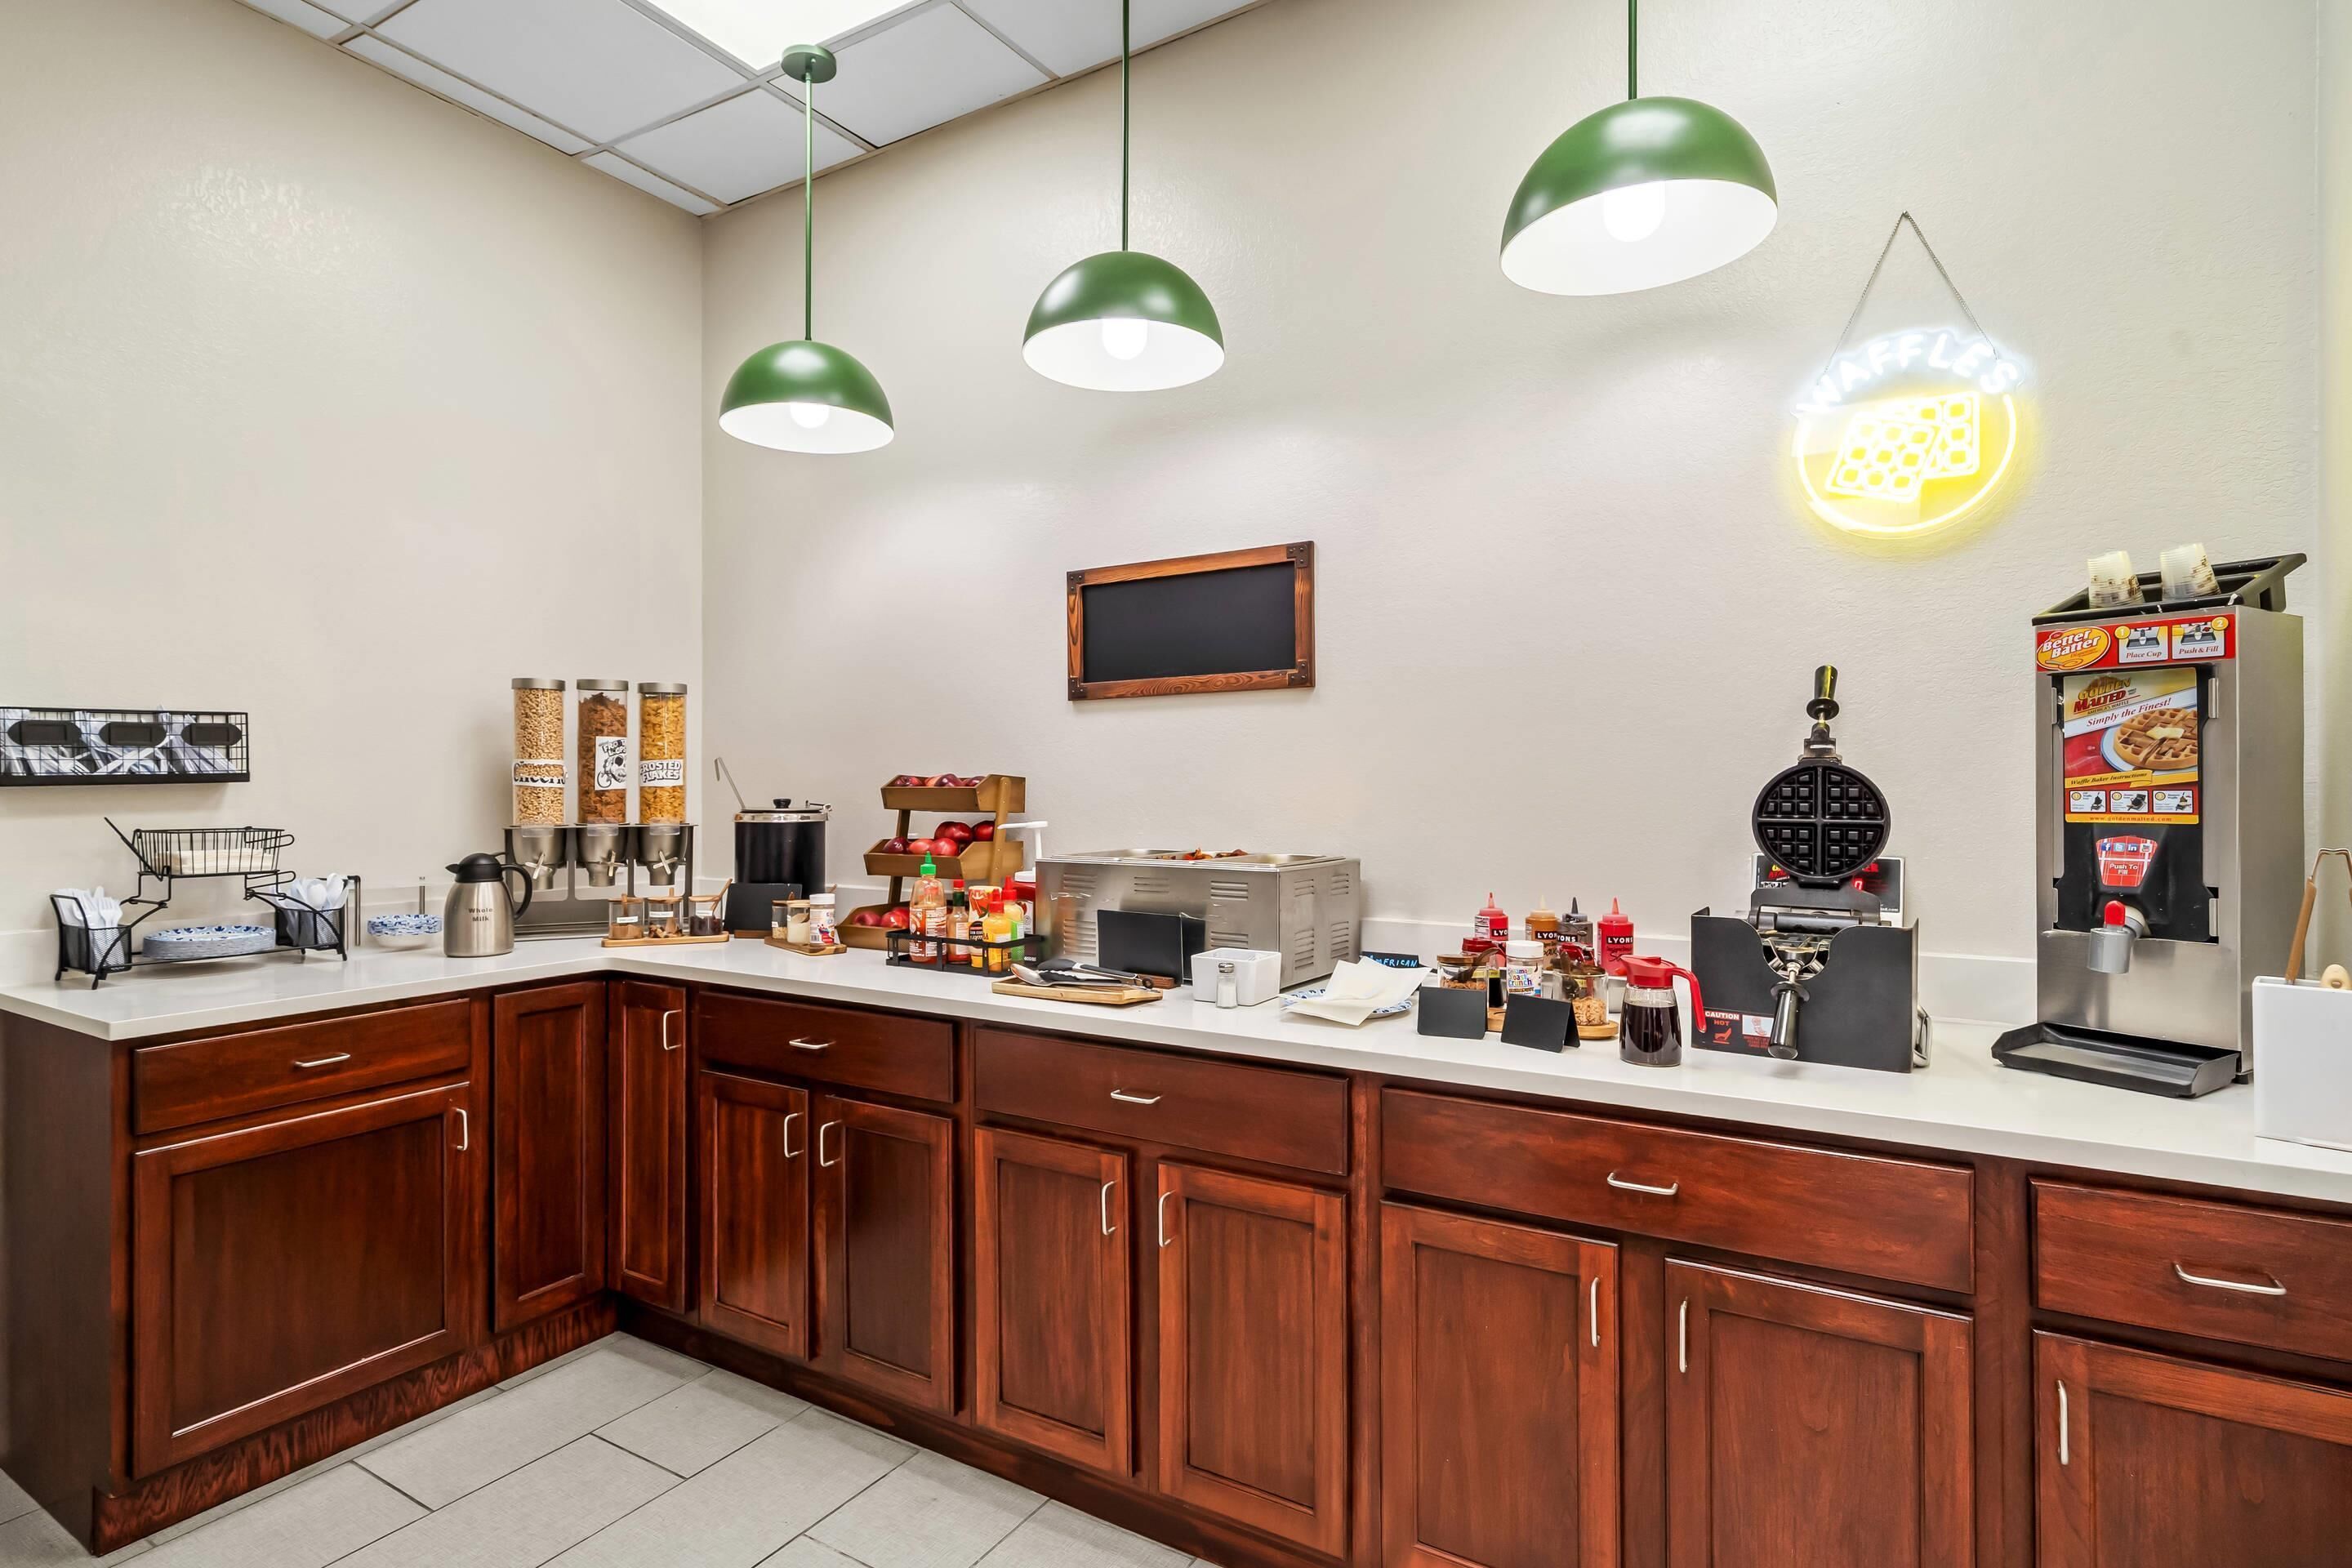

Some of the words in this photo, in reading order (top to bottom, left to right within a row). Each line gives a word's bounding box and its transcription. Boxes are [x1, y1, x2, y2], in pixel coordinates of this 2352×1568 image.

[1796, 333, 2018, 414] WAFFLES
[2042, 630, 2091, 653] Better
[2051, 636, 2100, 658] Batter
[2078, 678, 2132, 701] GOLDEN
[2074, 689, 2127, 713] MALTED
[2087, 713, 2119, 727] Simply
[2121, 707, 2137, 718] the
[2138, 697, 2172, 713] Finest!
[643, 769, 680, 783] FLAKES
[2109, 772, 2148, 781] Instructions
[1607, 936, 1633, 944] LYONS
[1705, 1011, 1740, 1020] CAUTION
